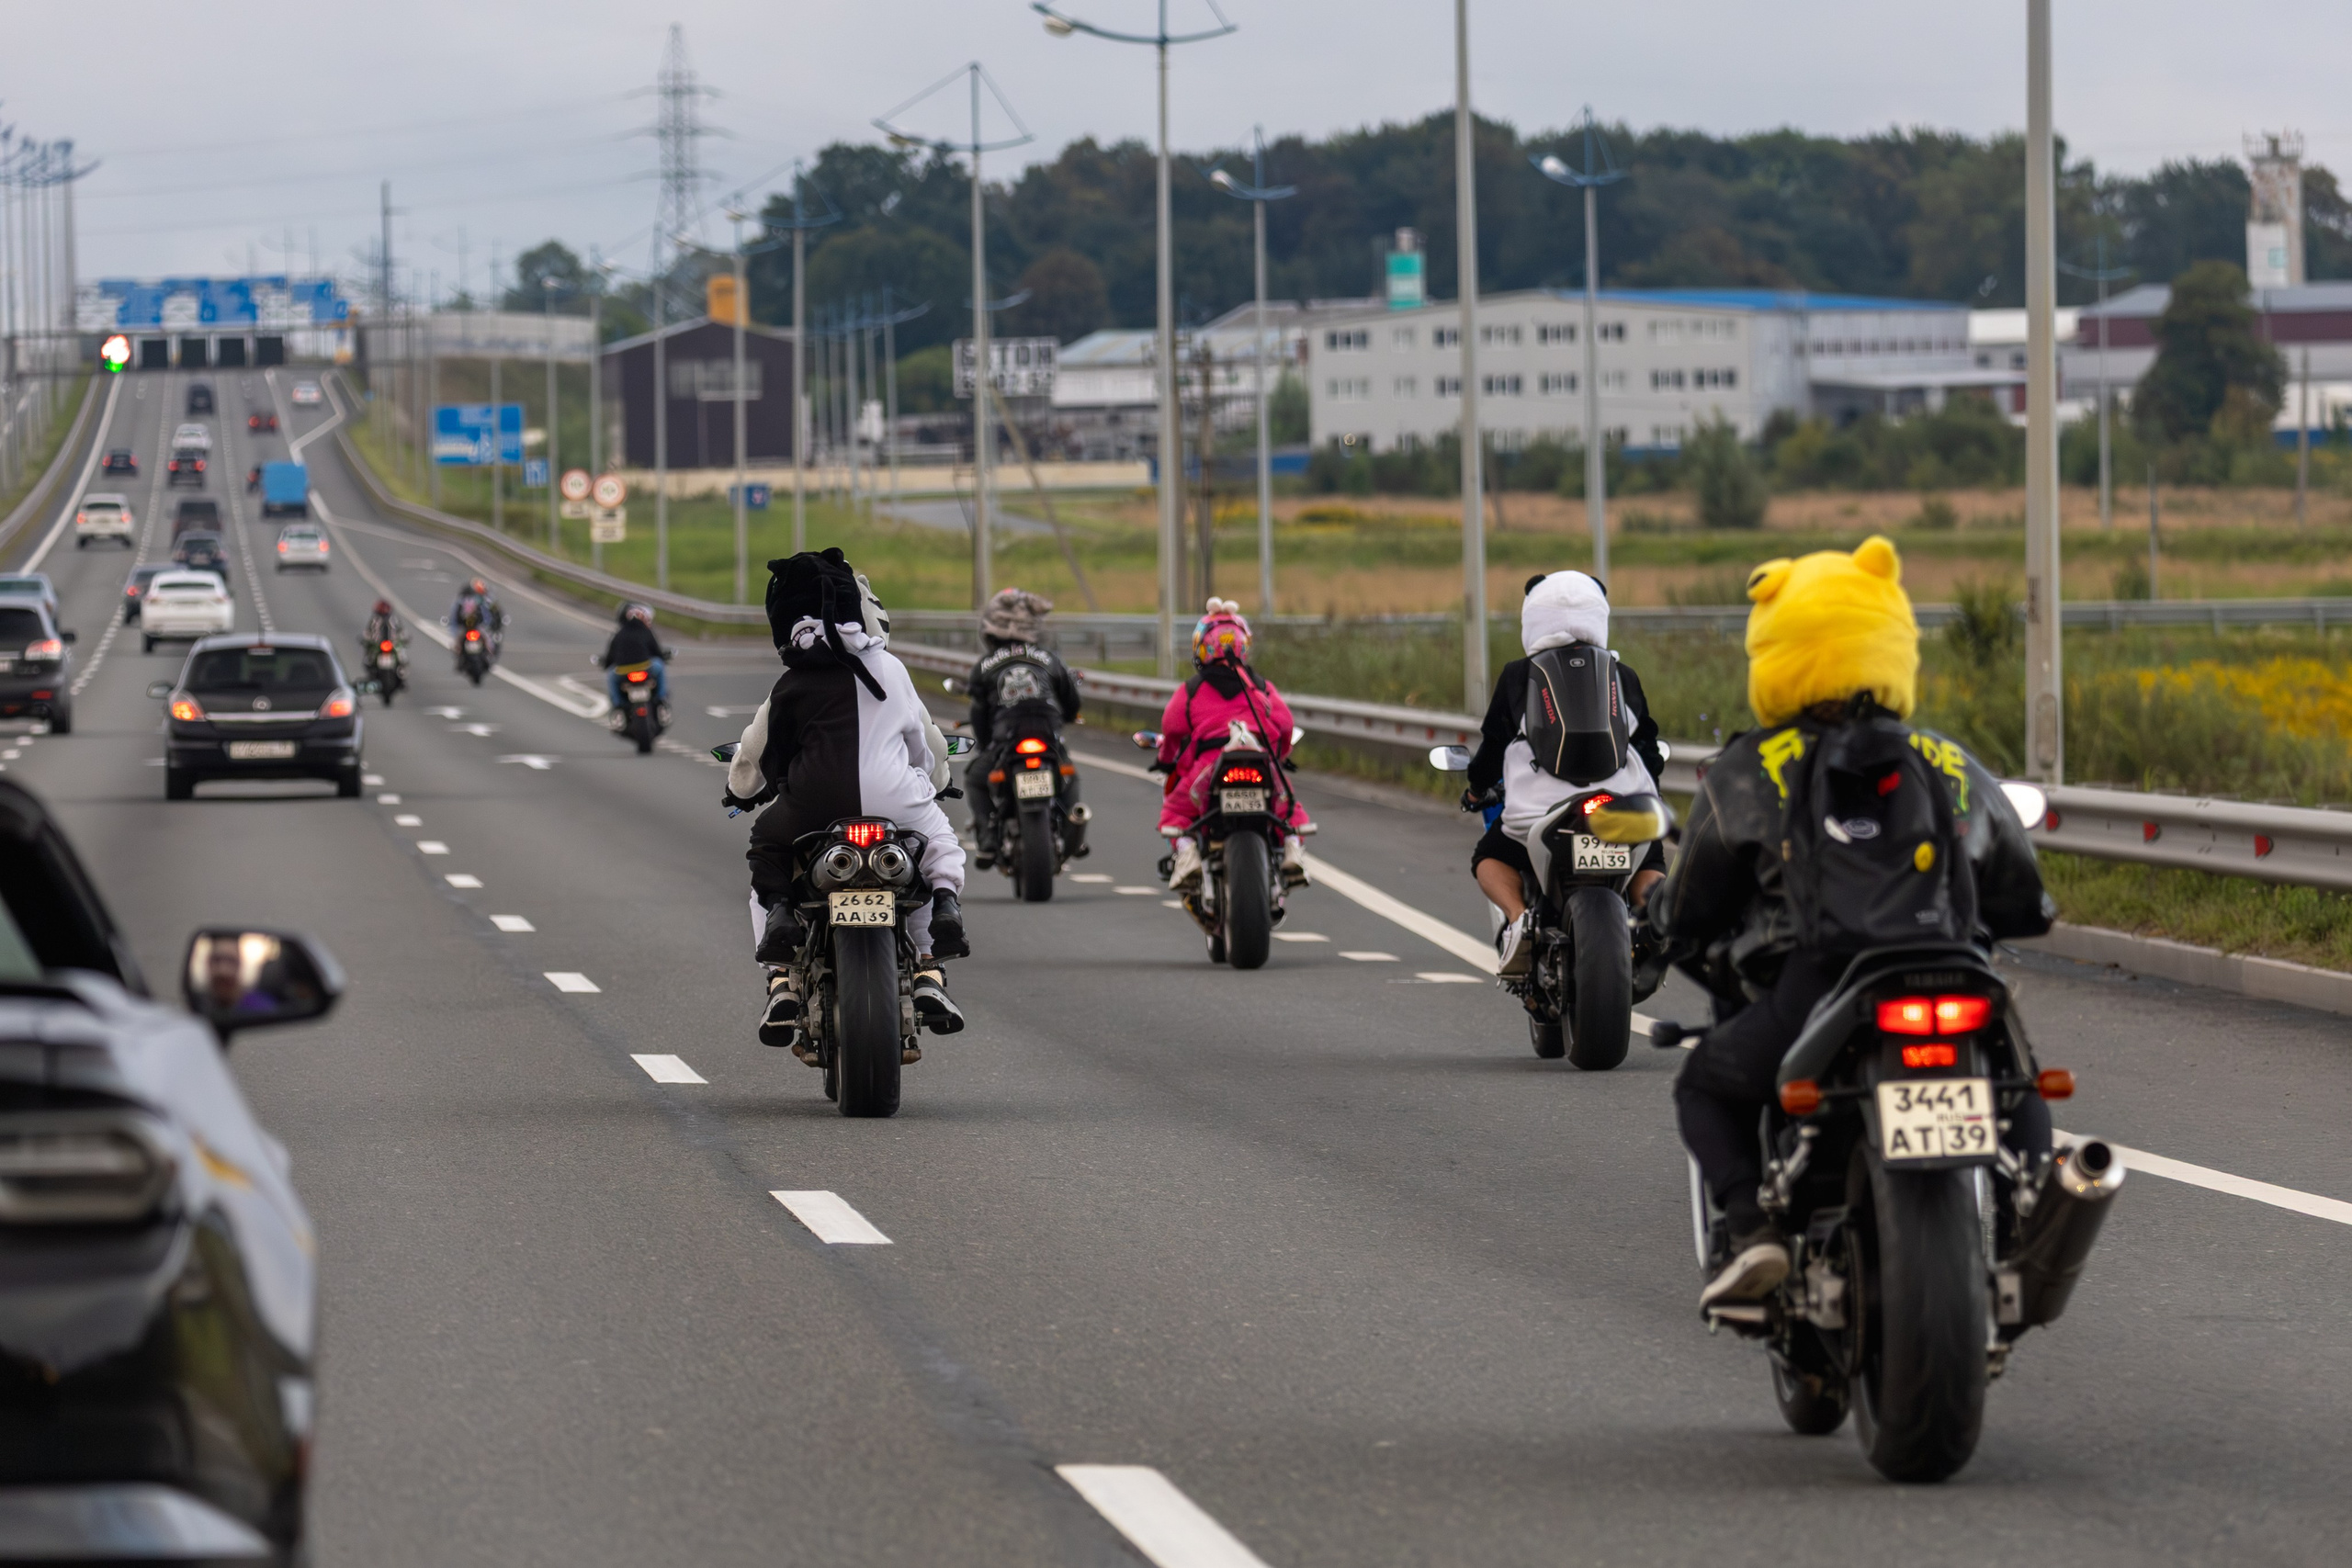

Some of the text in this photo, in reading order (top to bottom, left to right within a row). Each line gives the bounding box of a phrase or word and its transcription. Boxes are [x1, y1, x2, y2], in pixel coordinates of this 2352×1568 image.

[961, 344, 1052, 367] БТОН
[1542, 686, 1556, 725] HONDA
[1577, 855, 1626, 867] AA 39
[839, 895, 885, 906] 2662
[835, 911, 888, 922] AA 39
[1894, 1084, 1974, 1112] 3441
[1891, 1124, 1986, 1153] AT 39
